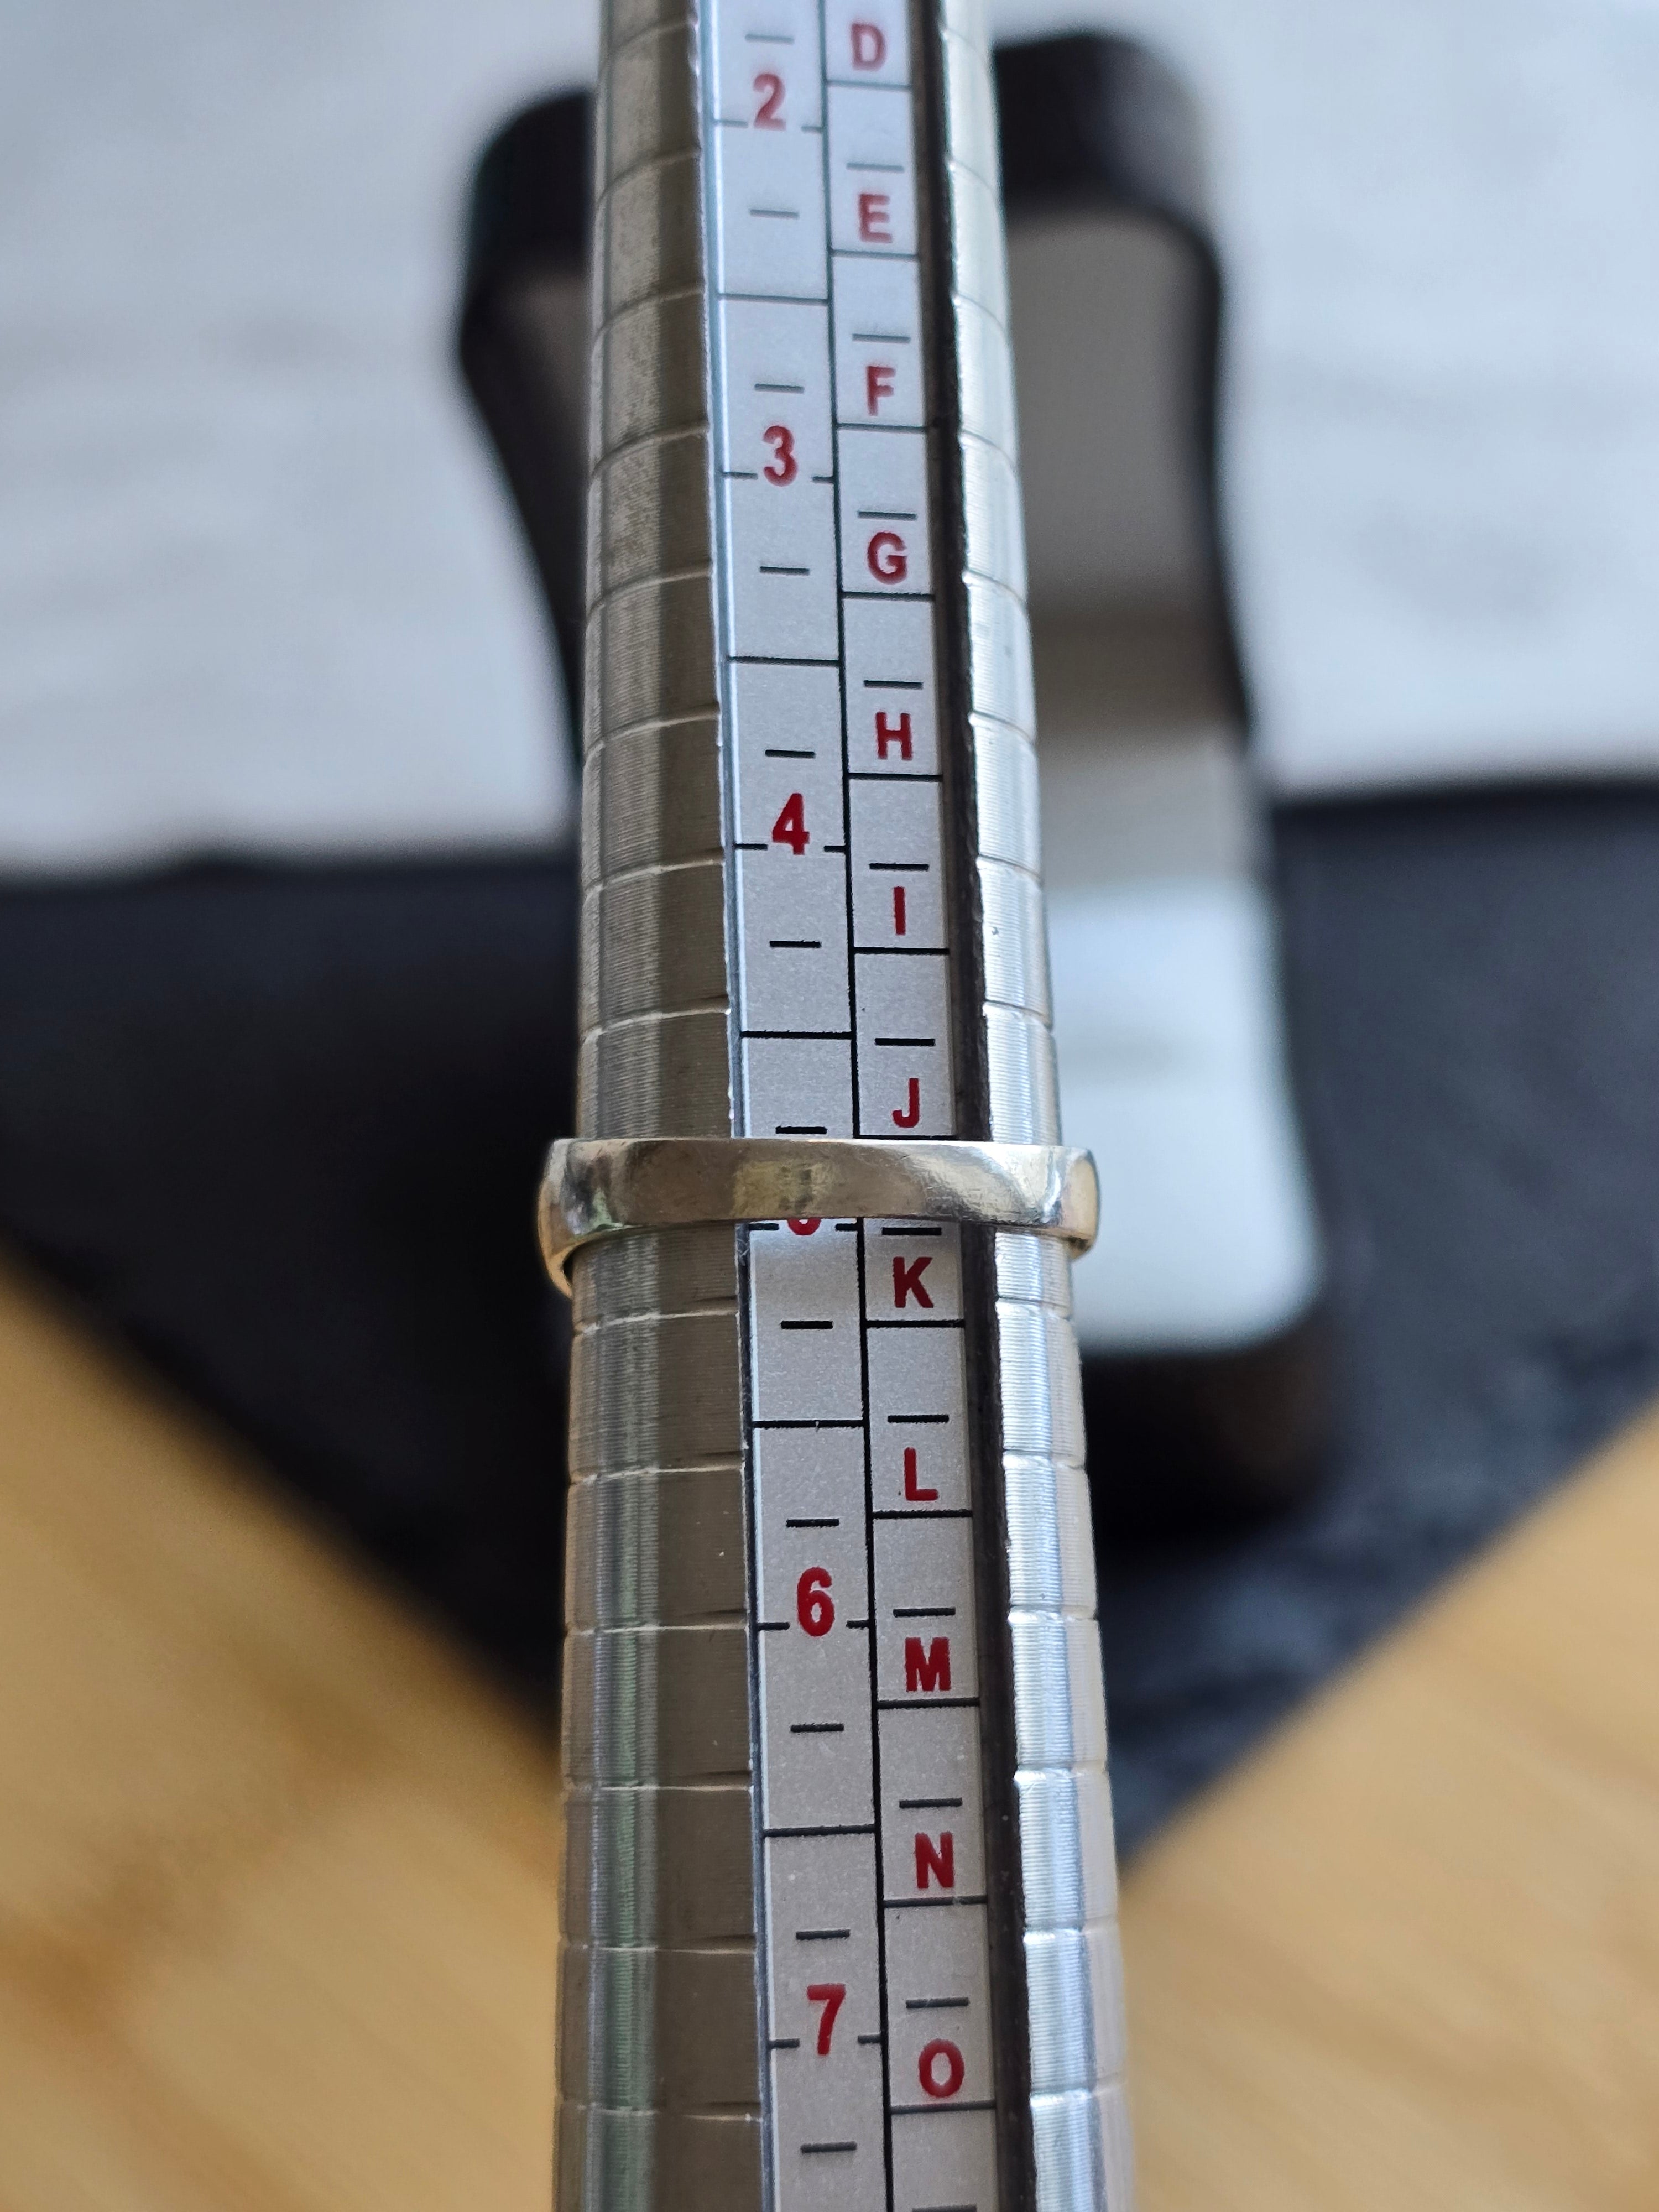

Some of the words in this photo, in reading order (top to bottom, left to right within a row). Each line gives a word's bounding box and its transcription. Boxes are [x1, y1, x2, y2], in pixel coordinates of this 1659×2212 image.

[851, 22, 887, 72] D
[752, 72, 787, 131] 2
[858, 193, 893, 243] E
[867, 366, 894, 415] F
[763, 425, 797, 485] 3
[867, 531, 907, 583] G
[875, 711, 912, 760] H
[772, 793, 808, 855] 4
[894, 886, 906, 935] I
[892, 1078, 920, 1128] J
[893, 1256, 933, 1308] K
[904, 1447, 938, 1501] L
[797, 1567, 834, 1637] 6
[905, 1637, 951, 1692] M
[914, 1833, 954, 1890] N
[807, 1984, 846, 2056] 7
[919, 2039, 964, 2099] O
